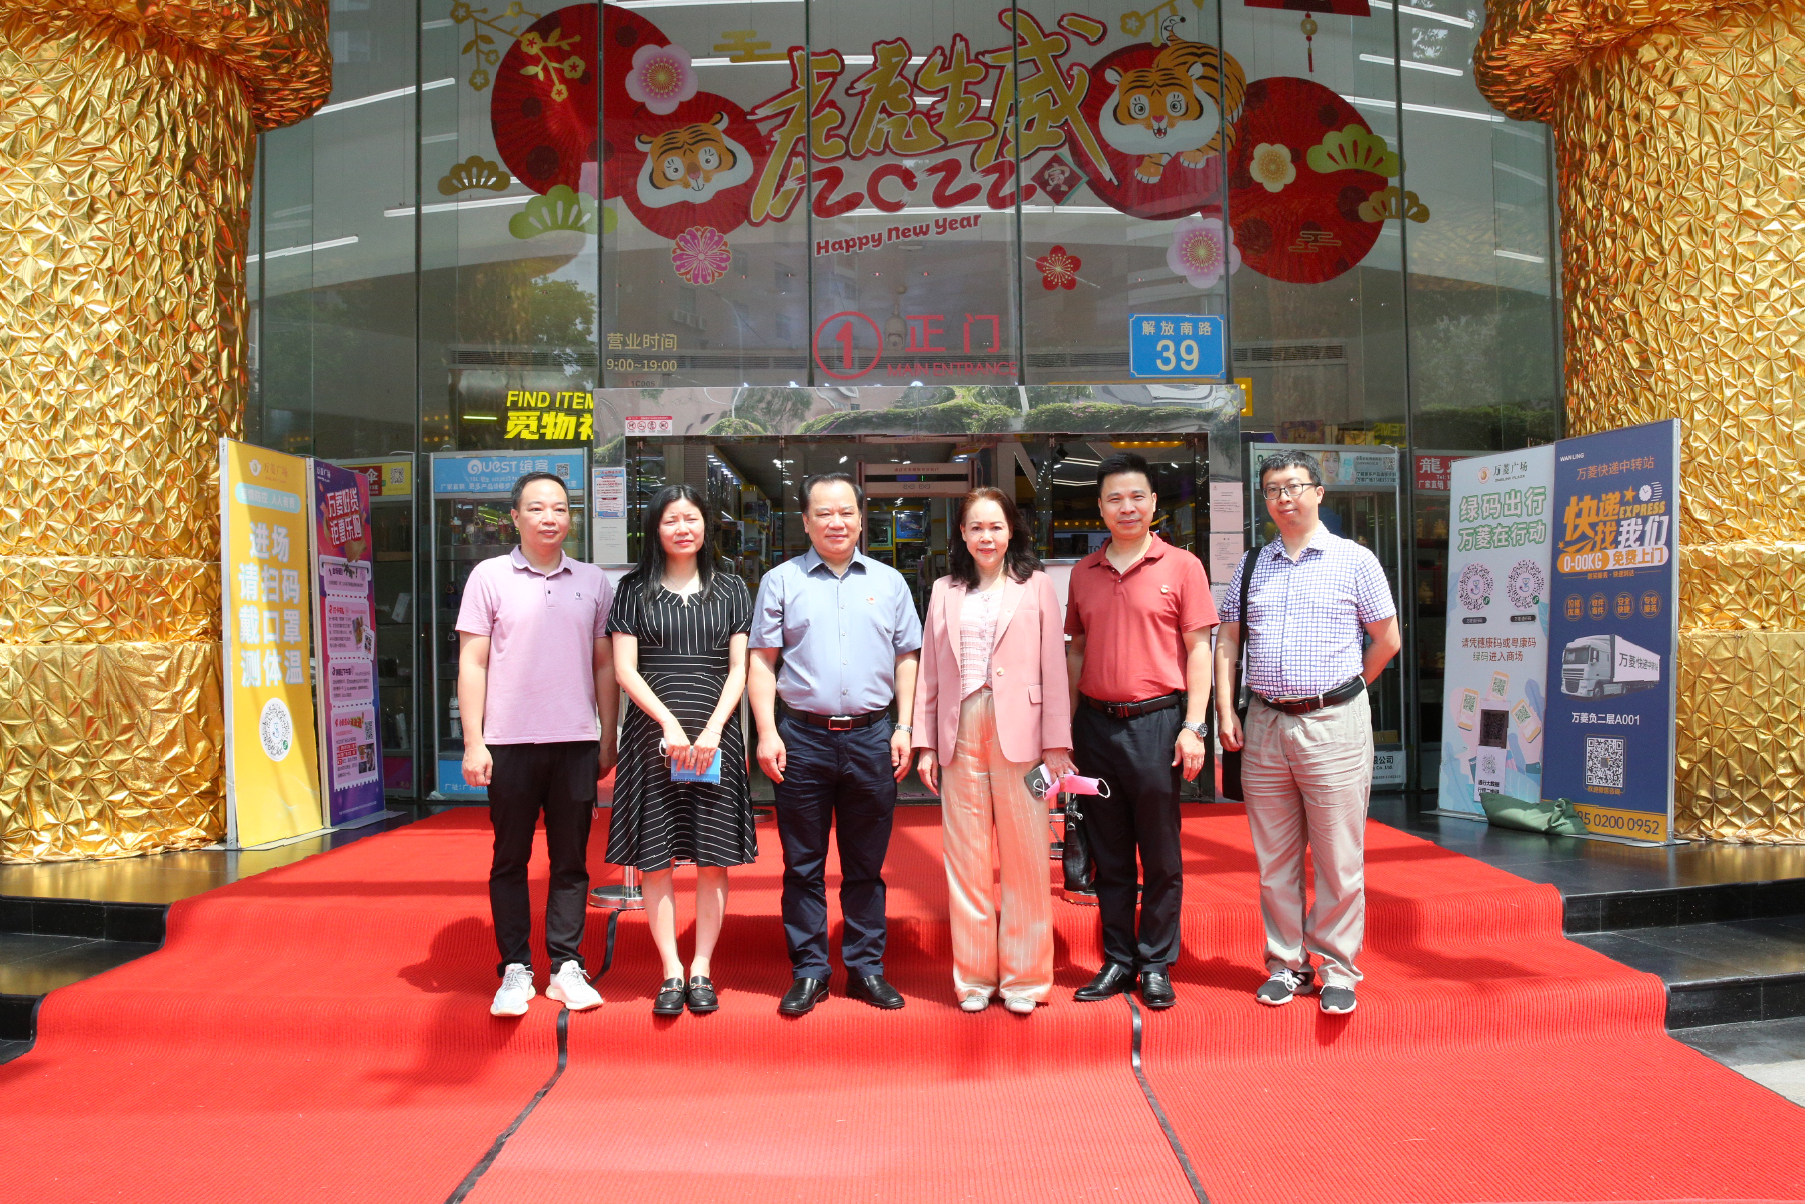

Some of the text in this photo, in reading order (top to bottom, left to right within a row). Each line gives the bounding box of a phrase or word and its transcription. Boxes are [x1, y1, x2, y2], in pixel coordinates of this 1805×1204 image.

[747, 8, 1118, 226] 虎虎生威
[786, 157, 1037, 218] 2022
[815, 214, 982, 257] Happy New Year
[904, 313, 1000, 354] 正门
[1142, 321, 1213, 336] 解放南路
[606, 333, 678, 351] 营业时间
[606, 359, 678, 372] 9:00~19:00
[1155, 340, 1200, 371] 39
[887, 361, 1018, 377] MAIN ENTRANCE
[506, 390, 550, 408] FIND
[520, 460, 549, 473] 缤客
[1493, 462, 1528, 477] 万菱广场
[1577, 456, 1655, 480] 万菱快递中转站
[1418, 480, 1444, 489] 厂家直销
[326, 487, 359, 518] 万菱好货
[1459, 486, 1547, 523] 绿码出行
[1619, 501, 1666, 519] EXPRESS
[1563, 491, 1621, 541] 快递
[249, 521, 290, 563] 进场
[1457, 519, 1547, 552] 万菱在行动
[1594, 515, 1669, 552] 找我们
[1564, 552, 1602, 571] 0-00KG
[1612, 548, 1664, 567] 免费上门
[238, 562, 300, 605] 请扫码
[239, 606, 302, 648] 戴口罩
[1461, 637, 1537, 649] 请凭穗康码或粤康码
[1473, 651, 1524, 662] 绿码进入商场
[240, 648, 304, 688] 测体温
[1571, 712, 1640, 725] 万菱负二层A001
[1594, 814, 1625, 829] 0200
[1627, 818, 1660, 835] 0952
